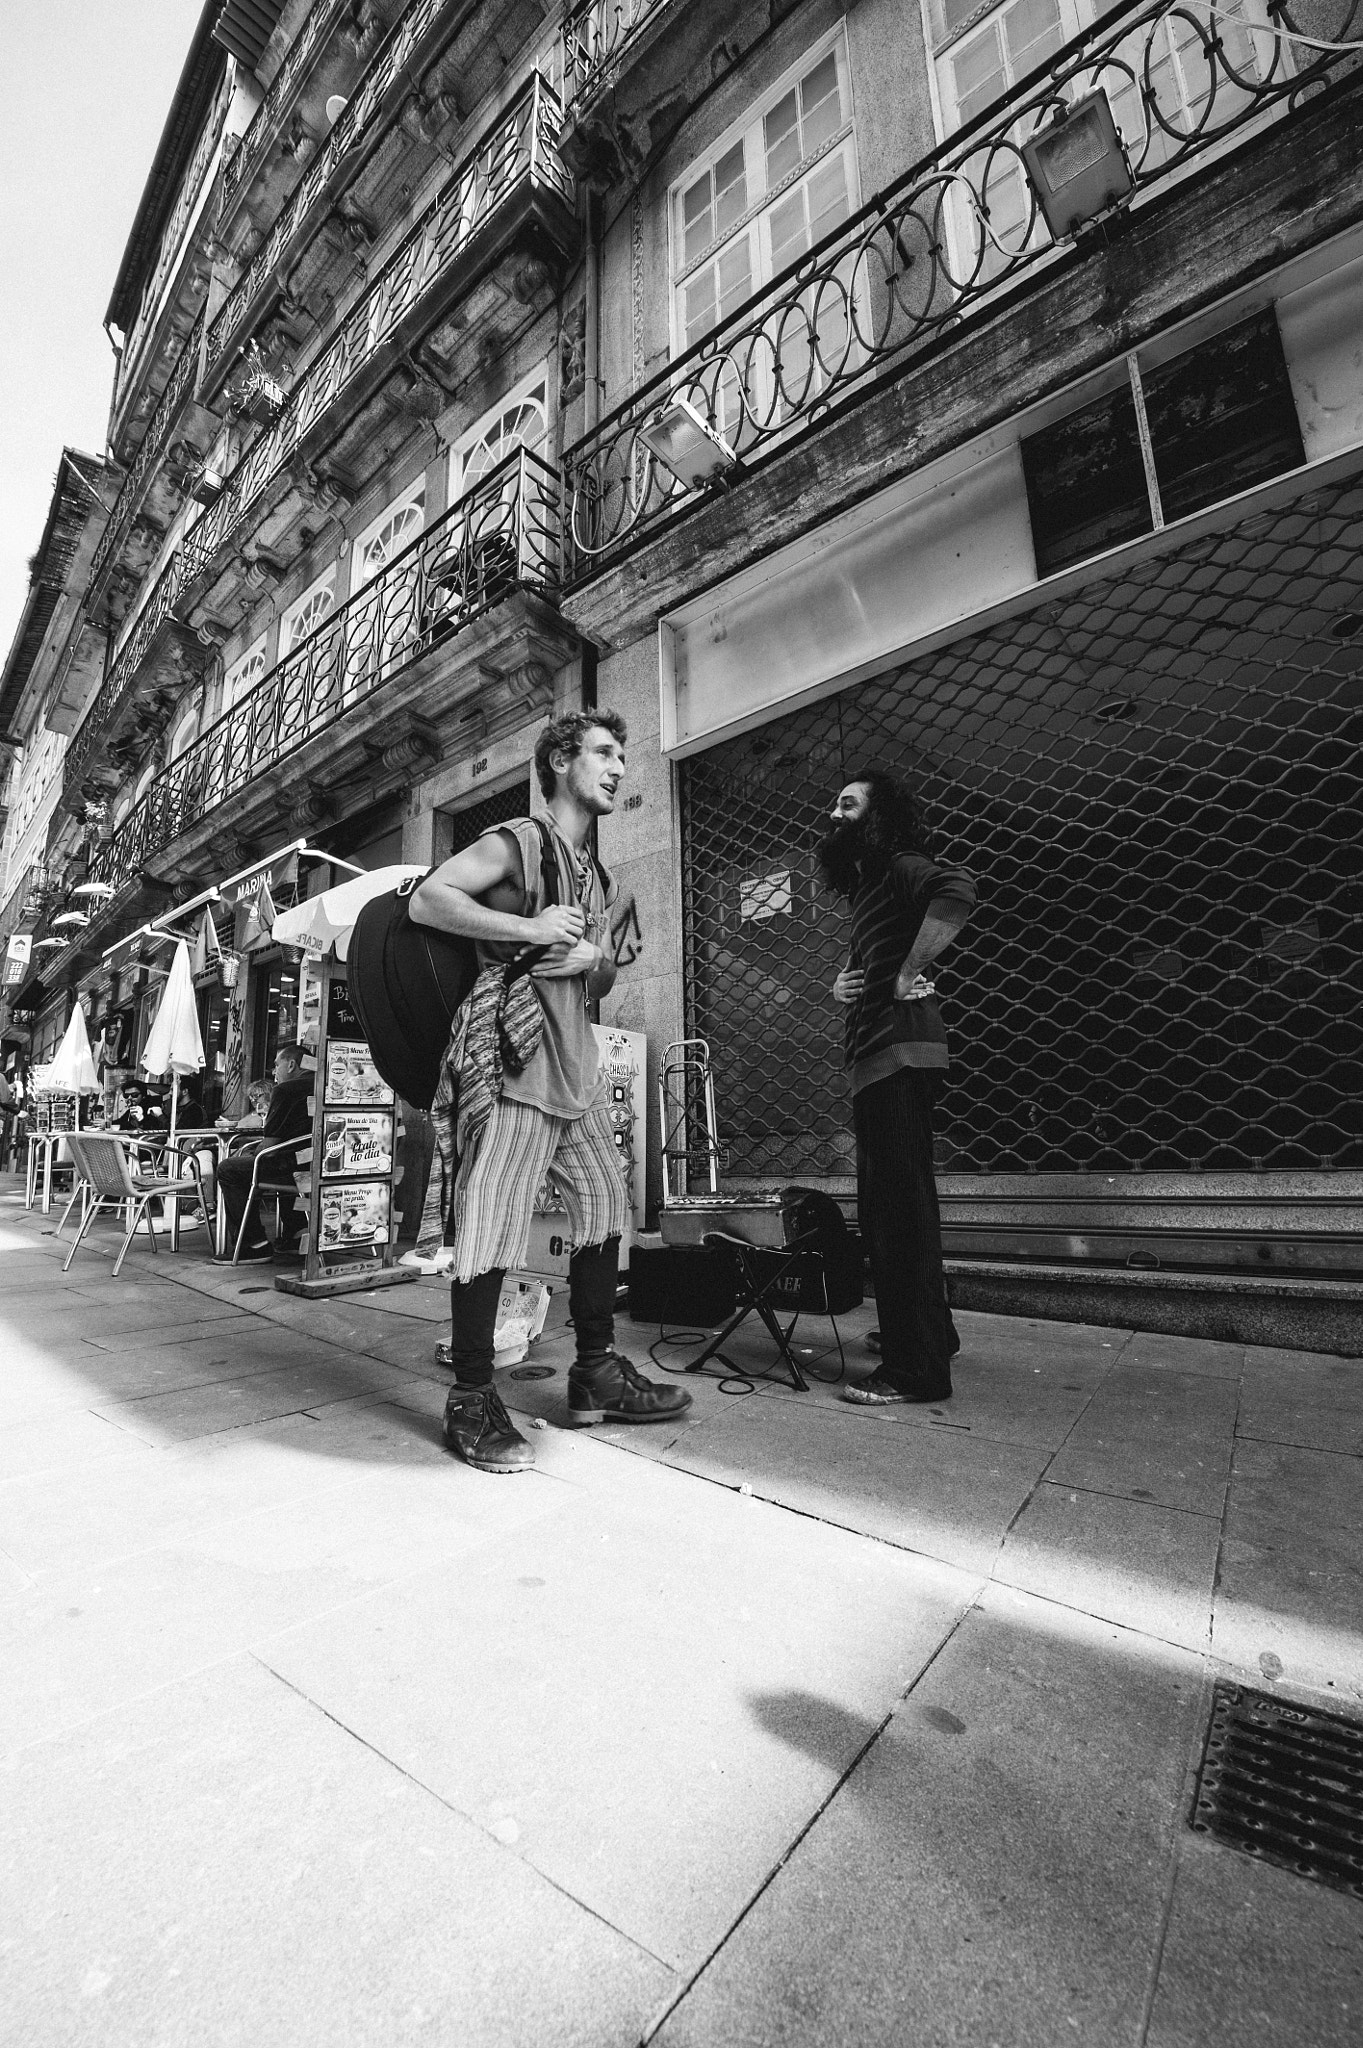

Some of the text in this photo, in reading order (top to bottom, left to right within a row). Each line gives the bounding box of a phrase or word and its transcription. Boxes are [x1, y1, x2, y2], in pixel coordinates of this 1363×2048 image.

[472, 757, 488, 778] 192
[236, 870, 273, 902] MARINA
[351, 1140, 378, 1153] Prato
[350, 1149, 380, 1162] do dia
[501, 1297, 512, 1308] CD
